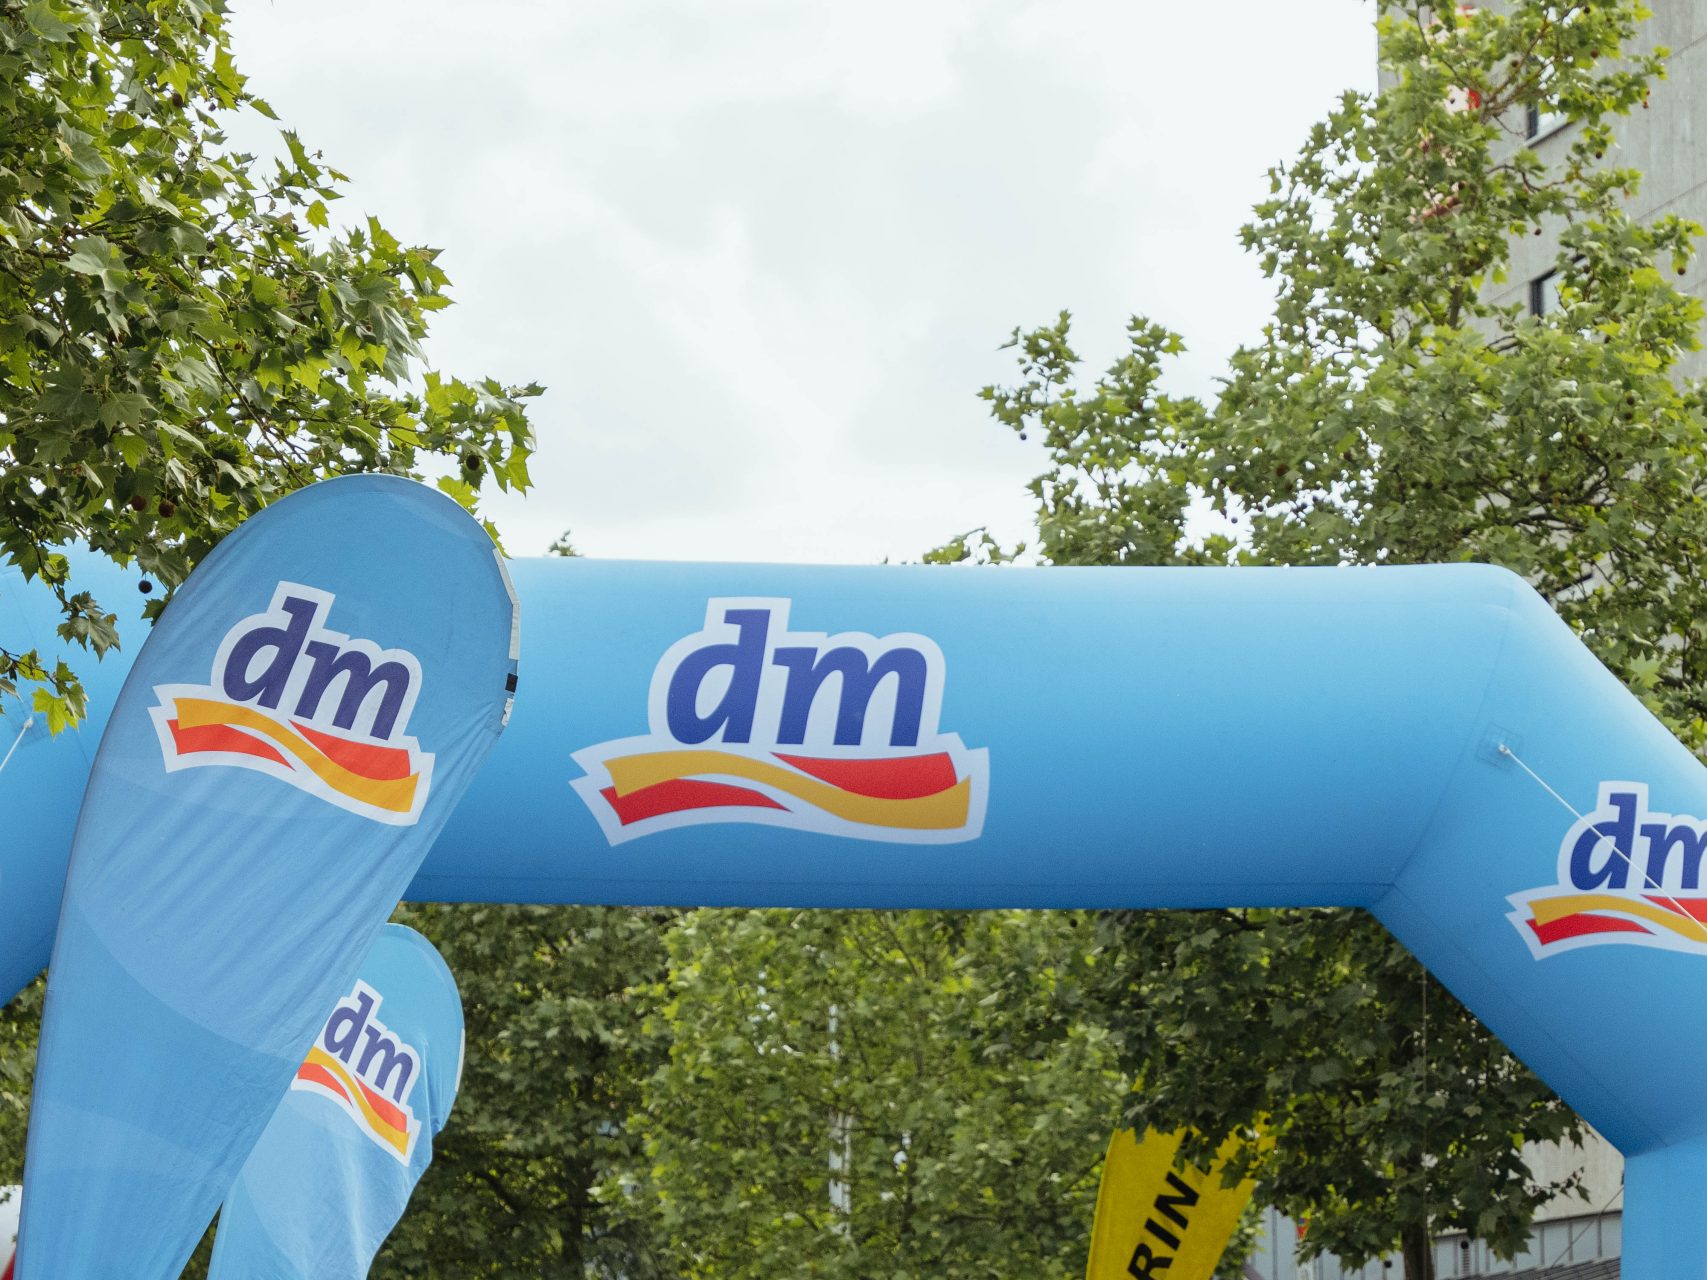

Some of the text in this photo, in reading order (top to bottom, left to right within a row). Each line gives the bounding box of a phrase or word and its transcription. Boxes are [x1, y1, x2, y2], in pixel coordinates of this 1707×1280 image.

[223, 596, 410, 740] dm
[666, 609, 927, 747] dm
[1569, 793, 1707, 890] dm
[324, 990, 413, 1104] dm
